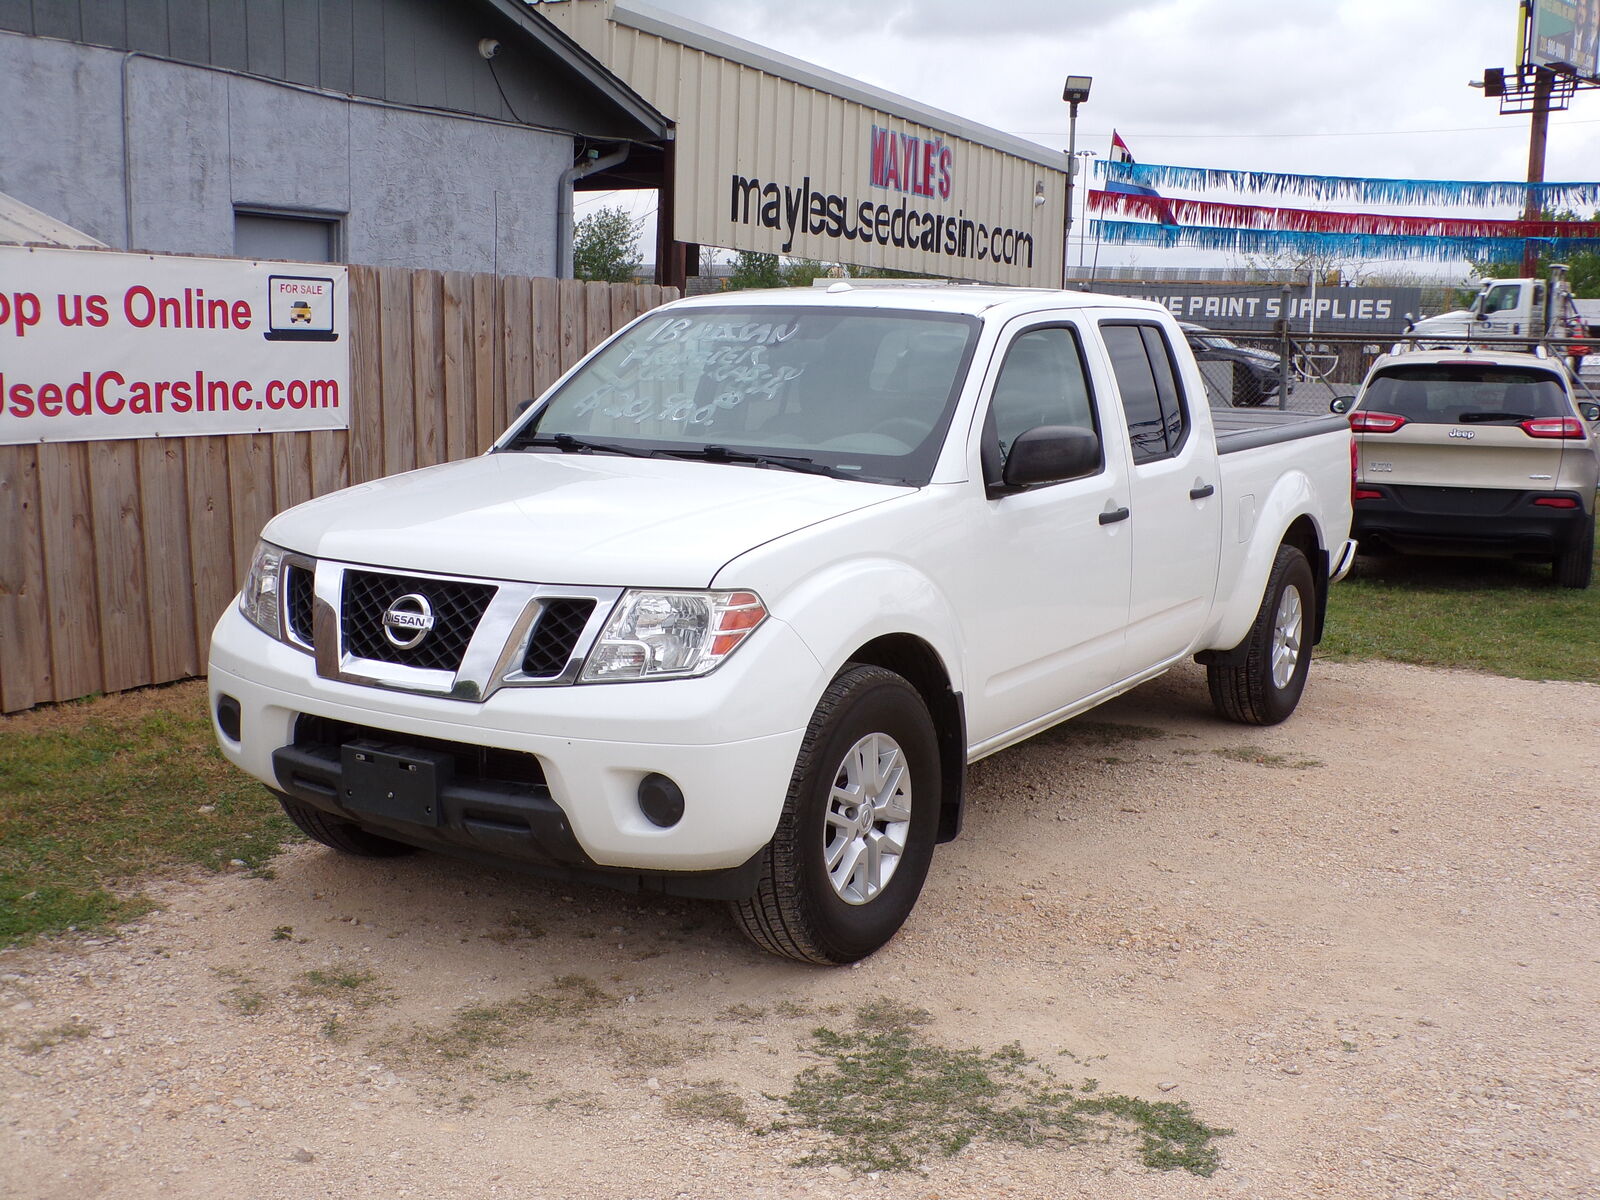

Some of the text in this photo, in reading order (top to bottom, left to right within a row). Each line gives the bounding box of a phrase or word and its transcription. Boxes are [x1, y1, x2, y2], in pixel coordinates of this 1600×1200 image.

[870, 124, 953, 201] MAYLE'S
[731, 174, 1033, 269] maylesusedcarsinccom
[280, 283, 323, 295] FOR SALE
[57, 293, 110, 327] us
[123, 284, 252, 330] Online
[1188, 297, 1260, 317] PAINT
[0, 370, 339, 419] sedCarsInc.com
[1449, 428, 1475, 440] Jeep
[384, 612, 426, 627] NISSAN
